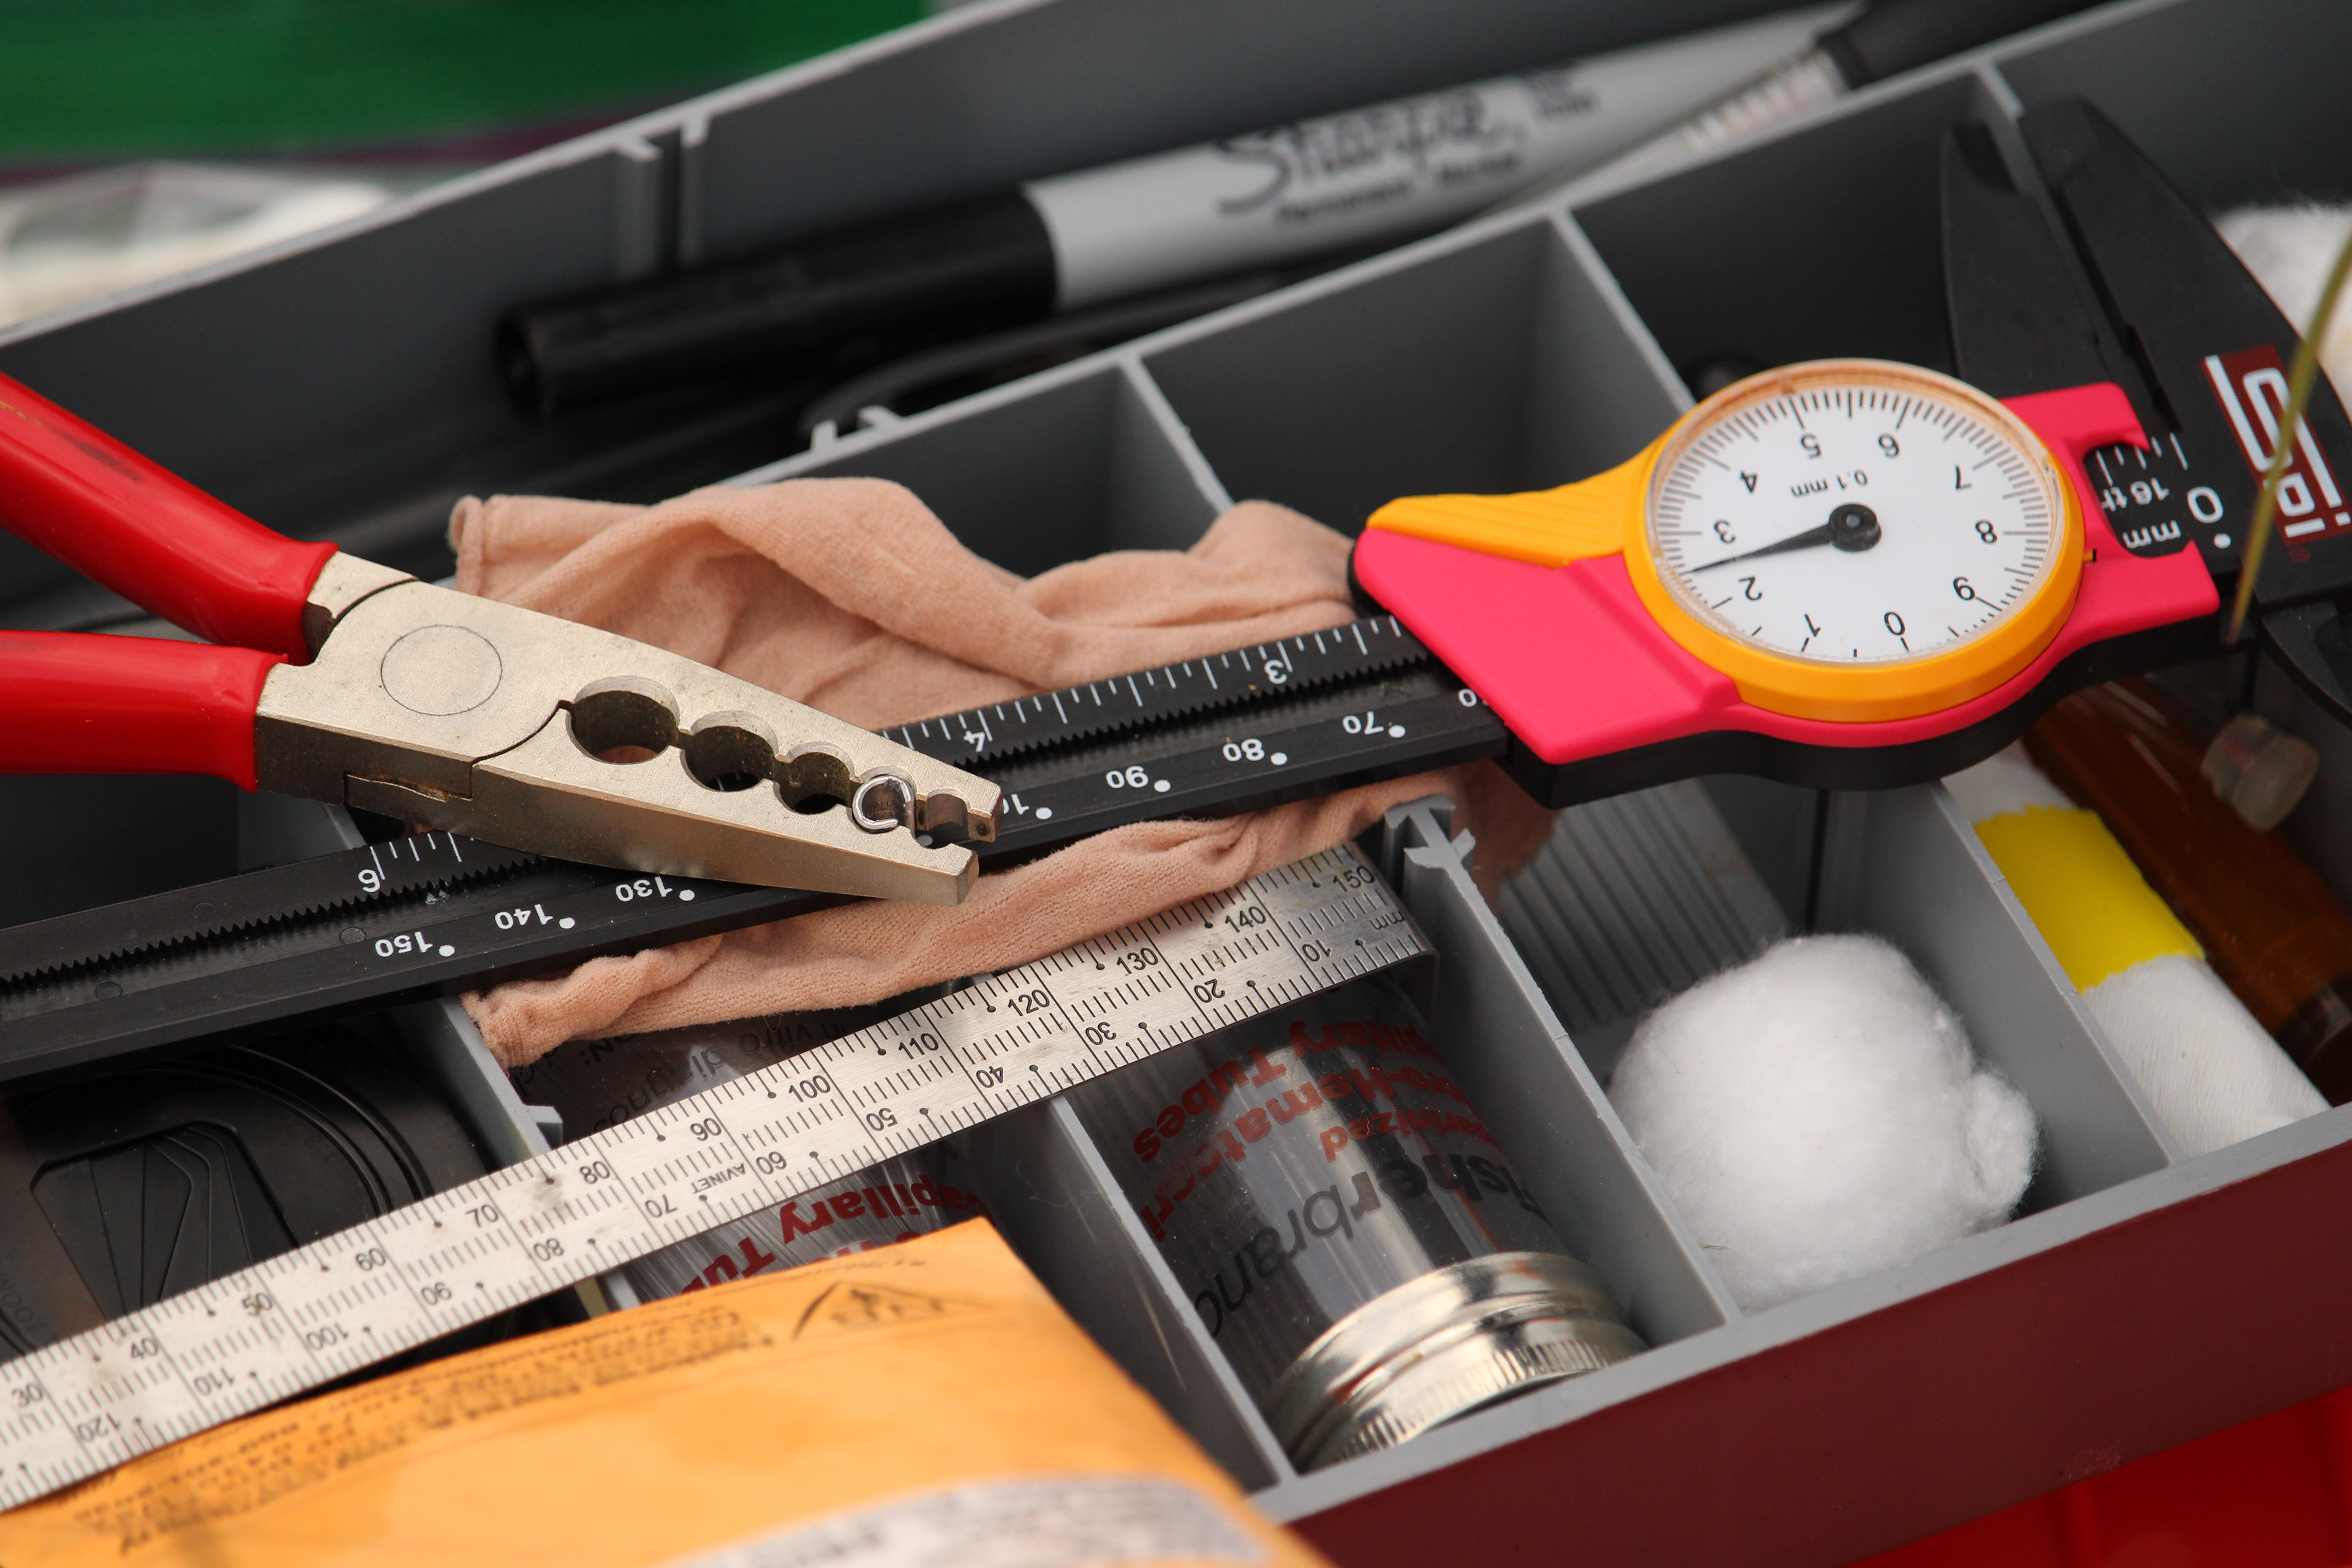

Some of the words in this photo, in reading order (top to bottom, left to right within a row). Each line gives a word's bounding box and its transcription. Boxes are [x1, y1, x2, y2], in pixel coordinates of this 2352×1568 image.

[1801, 434, 1823, 459] 5
[1878, 435, 1899, 458] 6
[1740, 471, 1758, 494] 4
[1791, 478, 1829, 499] mm
[1837, 470, 1868, 491] 0.1
[1954, 466, 1973, 491] 7
[2186, 486, 2224, 523] 0
[1713, 520, 1737, 545] 3
[1975, 519, 1998, 544] 8
[2122, 519, 2182, 549] mm
[1738, 576, 1763, 601] 2
[1953, 577, 1976, 601] 9
[1804, 613, 1822, 638] 1
[1883, 612, 1906, 636] 0
[1264, 658, 1288, 685] 3
[1342, 711, 1385, 736] 70
[964, 730, 986, 752] 4
[1223, 737, 1266, 762] 80
[1105, 764, 1149, 790] 90
[615, 876, 674, 902] 130
[494, 903, 554, 930] 140
[374, 931, 433, 957] 150
[1302, 941, 1332, 964] 10
[1193, 978, 1226, 1004] 20
[740, 1025, 814, 1055] vitro
[1085, 1021, 1118, 1047] 30
[975, 1065, 1005, 1089] 40
[1133, 1046, 1288, 1163] Tubes
[865, 1107, 898, 1131] 50
[10, 1382, 44, 1409] 30
[128, 1338, 160, 1361] 40
[242, 1292, 274, 1316] 50
[355, 1248, 386, 1272] 60
[466, 1204, 500, 1229] 70
[579, 1160, 611, 1185] 80
[690, 1117, 723, 1141] 90
[787, 1074, 832, 1102] 100
[896, 1033, 940, 1061] 110
[1007, 988, 1051, 1016] 120
[1116, 946, 1159, 976] 130
[1224, 906, 1267, 933] 140
[1332, 865, 1376, 893] 150
[755, 1151, 787, 1175] 60
[690, 1163, 747, 1195] AVINET
[644, 1198, 679, 1219] 70
[532, 1237, 565, 1262] 80
[420, 1281, 453, 1306] 90
[306, 1322, 349, 1351] 100
[194, 1368, 235, 1396] 110
[77, 1413, 121, 1442] 120
